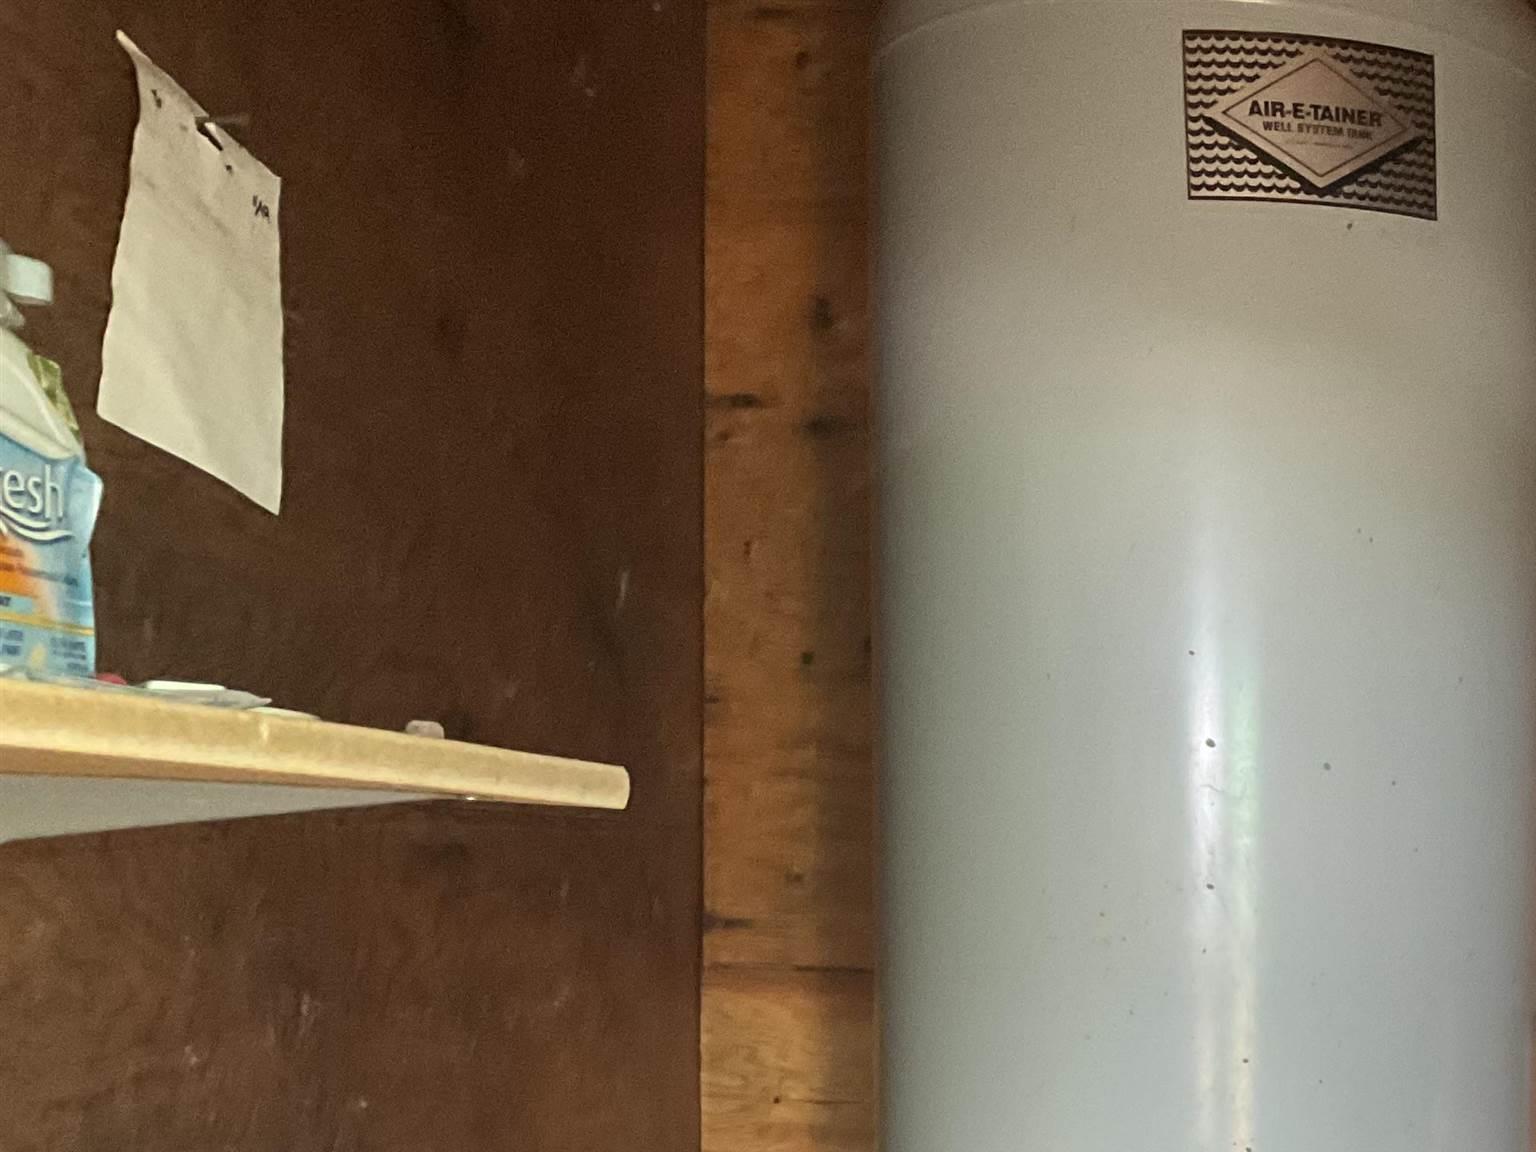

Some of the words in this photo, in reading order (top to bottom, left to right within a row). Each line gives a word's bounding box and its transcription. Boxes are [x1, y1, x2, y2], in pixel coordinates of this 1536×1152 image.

[1248, 100, 1382, 126] AIR-E-TAINER
[1262, 121, 1292, 133] WELL
[1297, 123, 1344, 137] SYSTEM
[0, 464, 64, 519] esh
